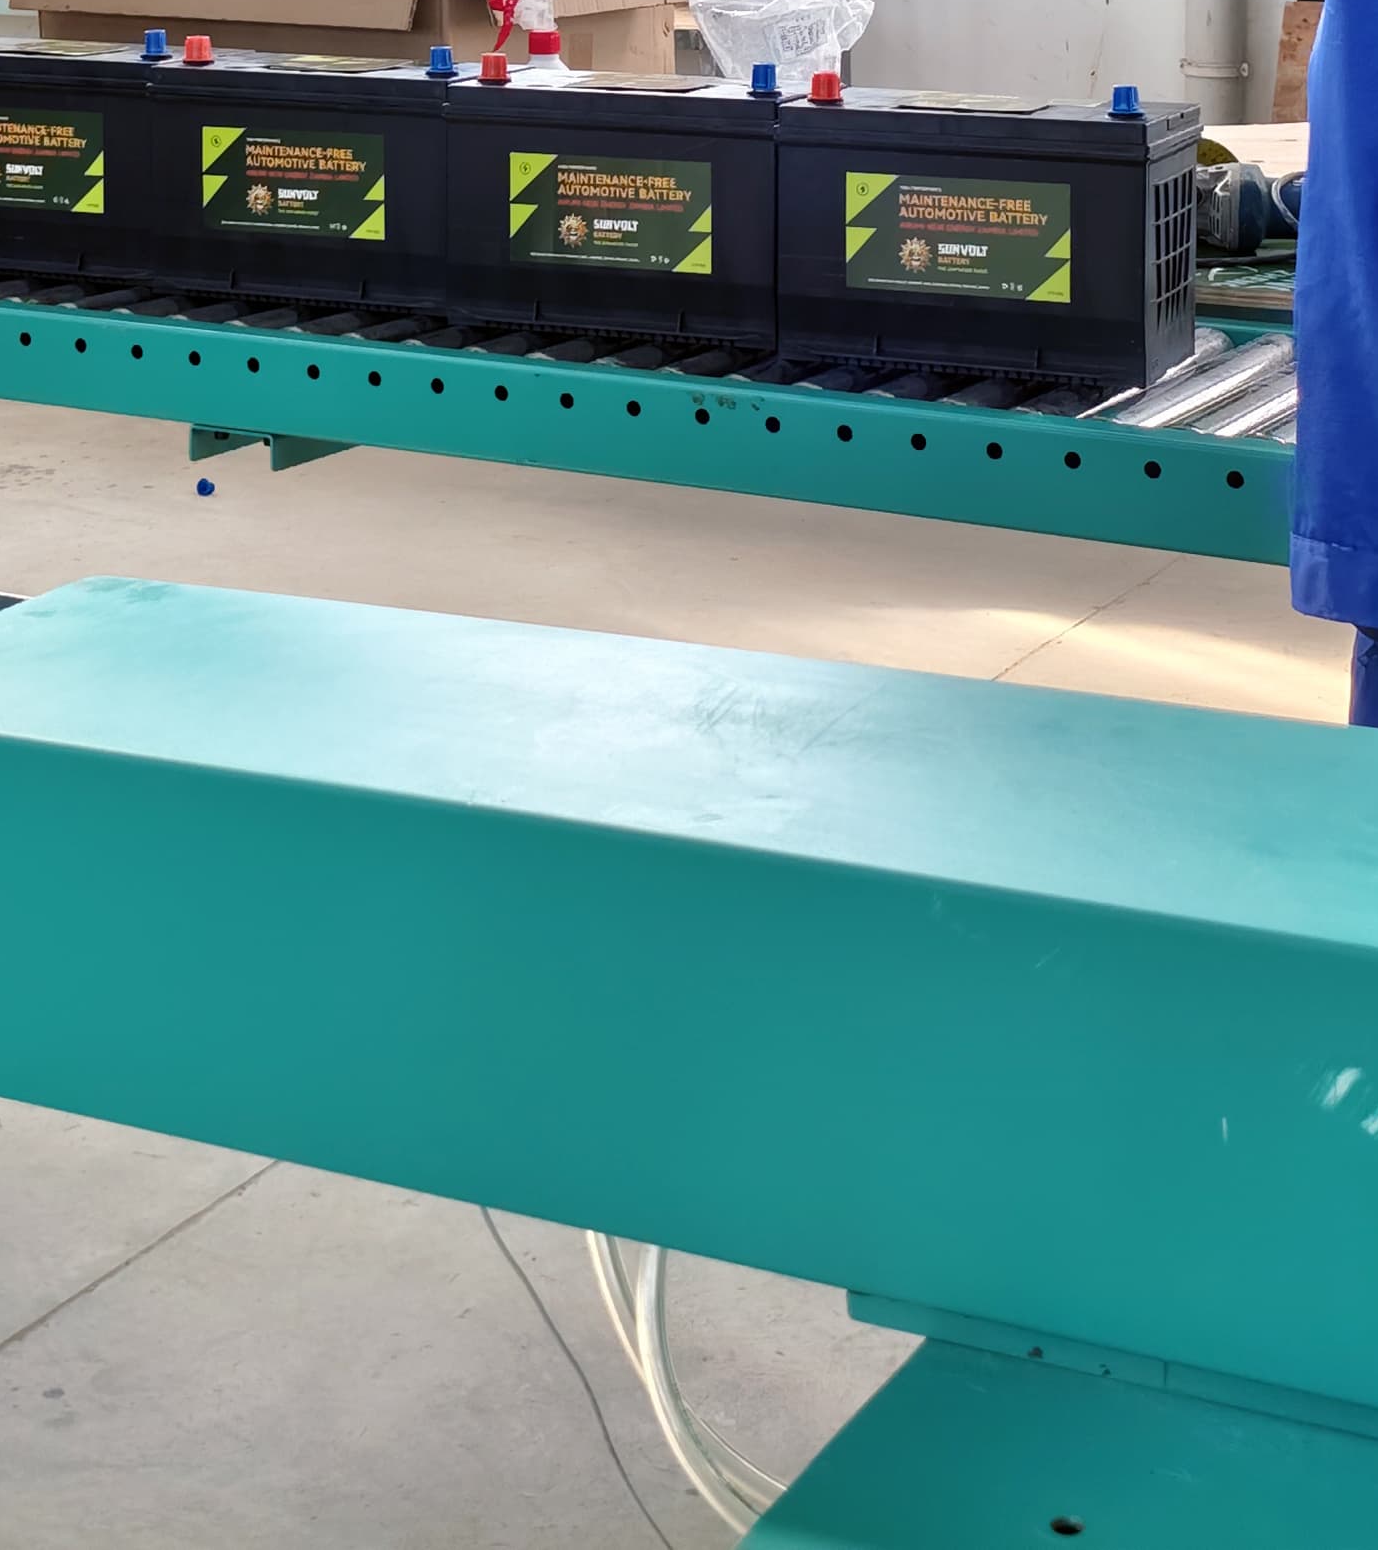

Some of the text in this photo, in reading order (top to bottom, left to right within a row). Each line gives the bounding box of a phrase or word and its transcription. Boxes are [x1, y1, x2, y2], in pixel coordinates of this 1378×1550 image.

[43, 136, 87, 149] BATTERY
[245, 144, 353, 159] MAINTENANCE-FREE
[245, 156, 367, 172] AUTOMOTIVE BATTERY
[557, 172, 677, 189] MAINTENANCE-FREE
[557, 185, 692, 202] AUTOMOTIVE BATTERY
[899, 193, 1031, 212] MAINTENANCE-FREE
[899, 206, 1048, 226] AUTOMOTIVE BATTERY
[593, 218, 638, 232] SUNVOLT
[937, 243, 989, 258] SUNVOLT
